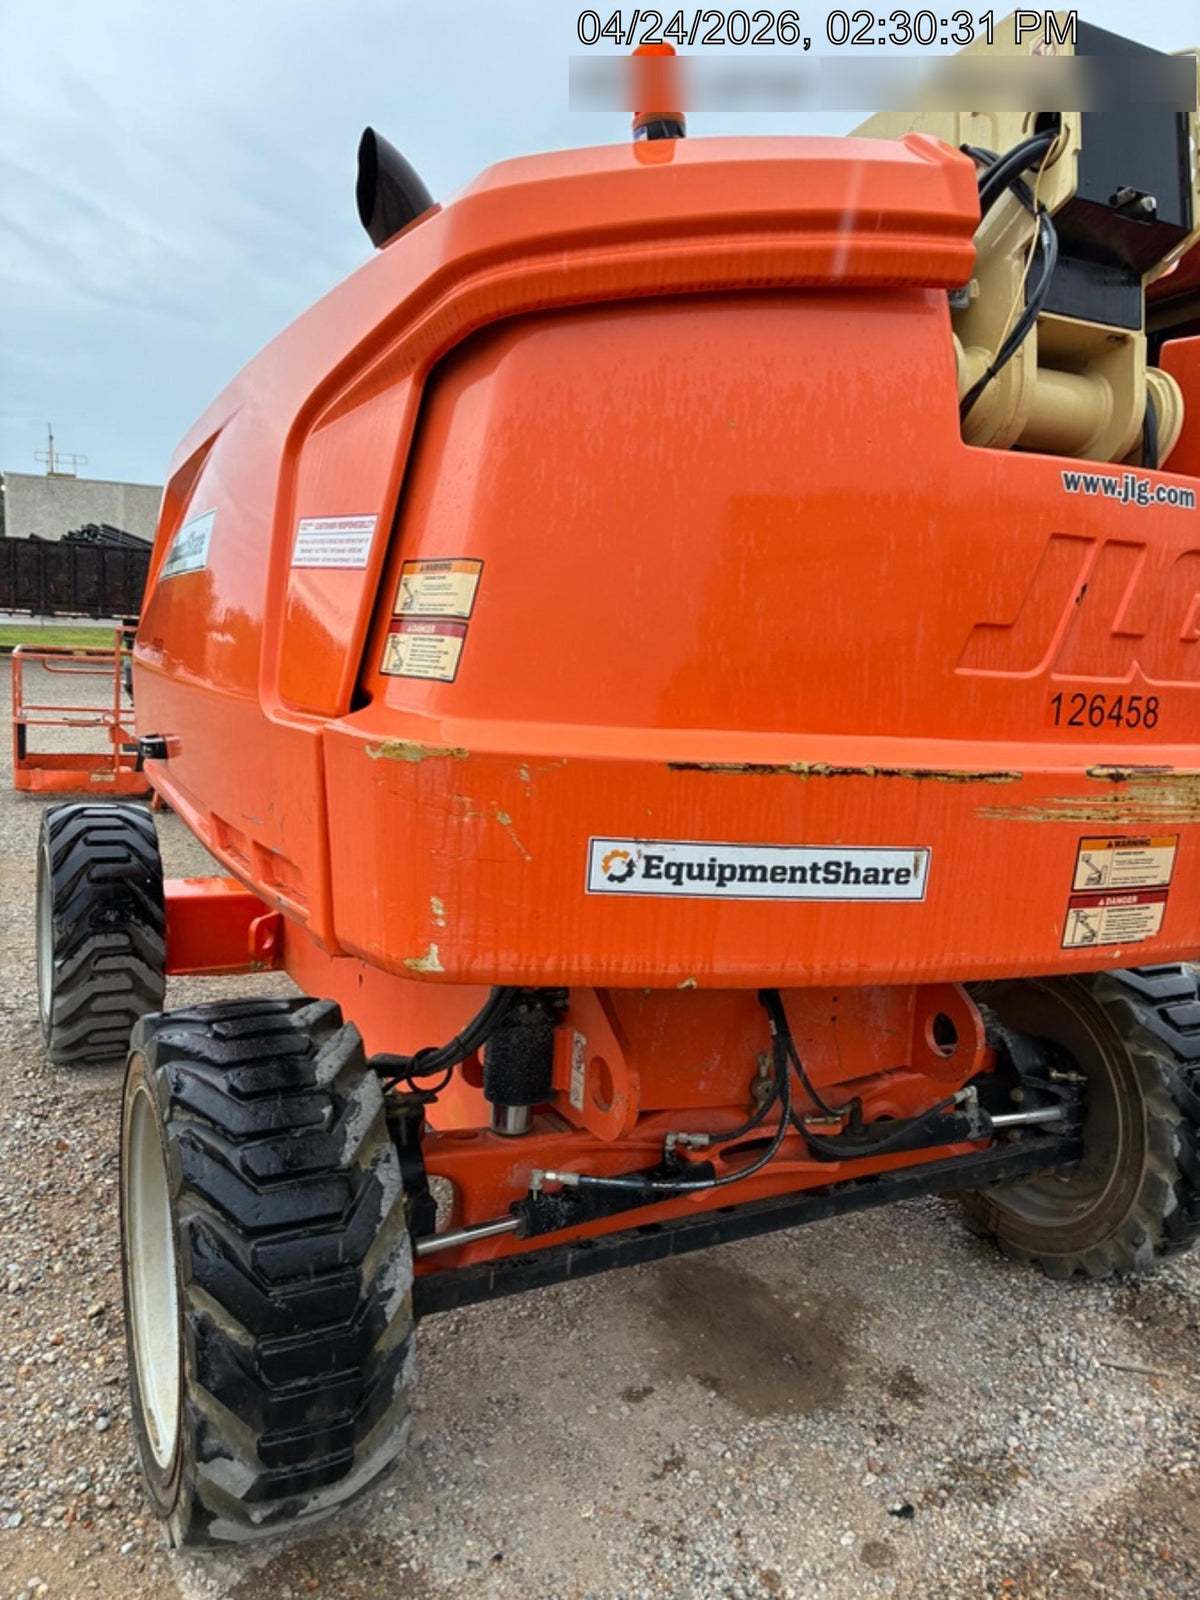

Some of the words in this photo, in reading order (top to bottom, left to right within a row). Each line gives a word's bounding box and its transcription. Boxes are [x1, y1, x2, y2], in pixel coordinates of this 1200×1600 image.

[1062, 471, 1196, 508] www.jlg.com
[1050, 692, 1160, 729] 126458
[1114, 839, 1152, 848] WARNING
[641, 854, 911, 887] EquipmentShare
[1105, 895, 1138, 905] DANGER
